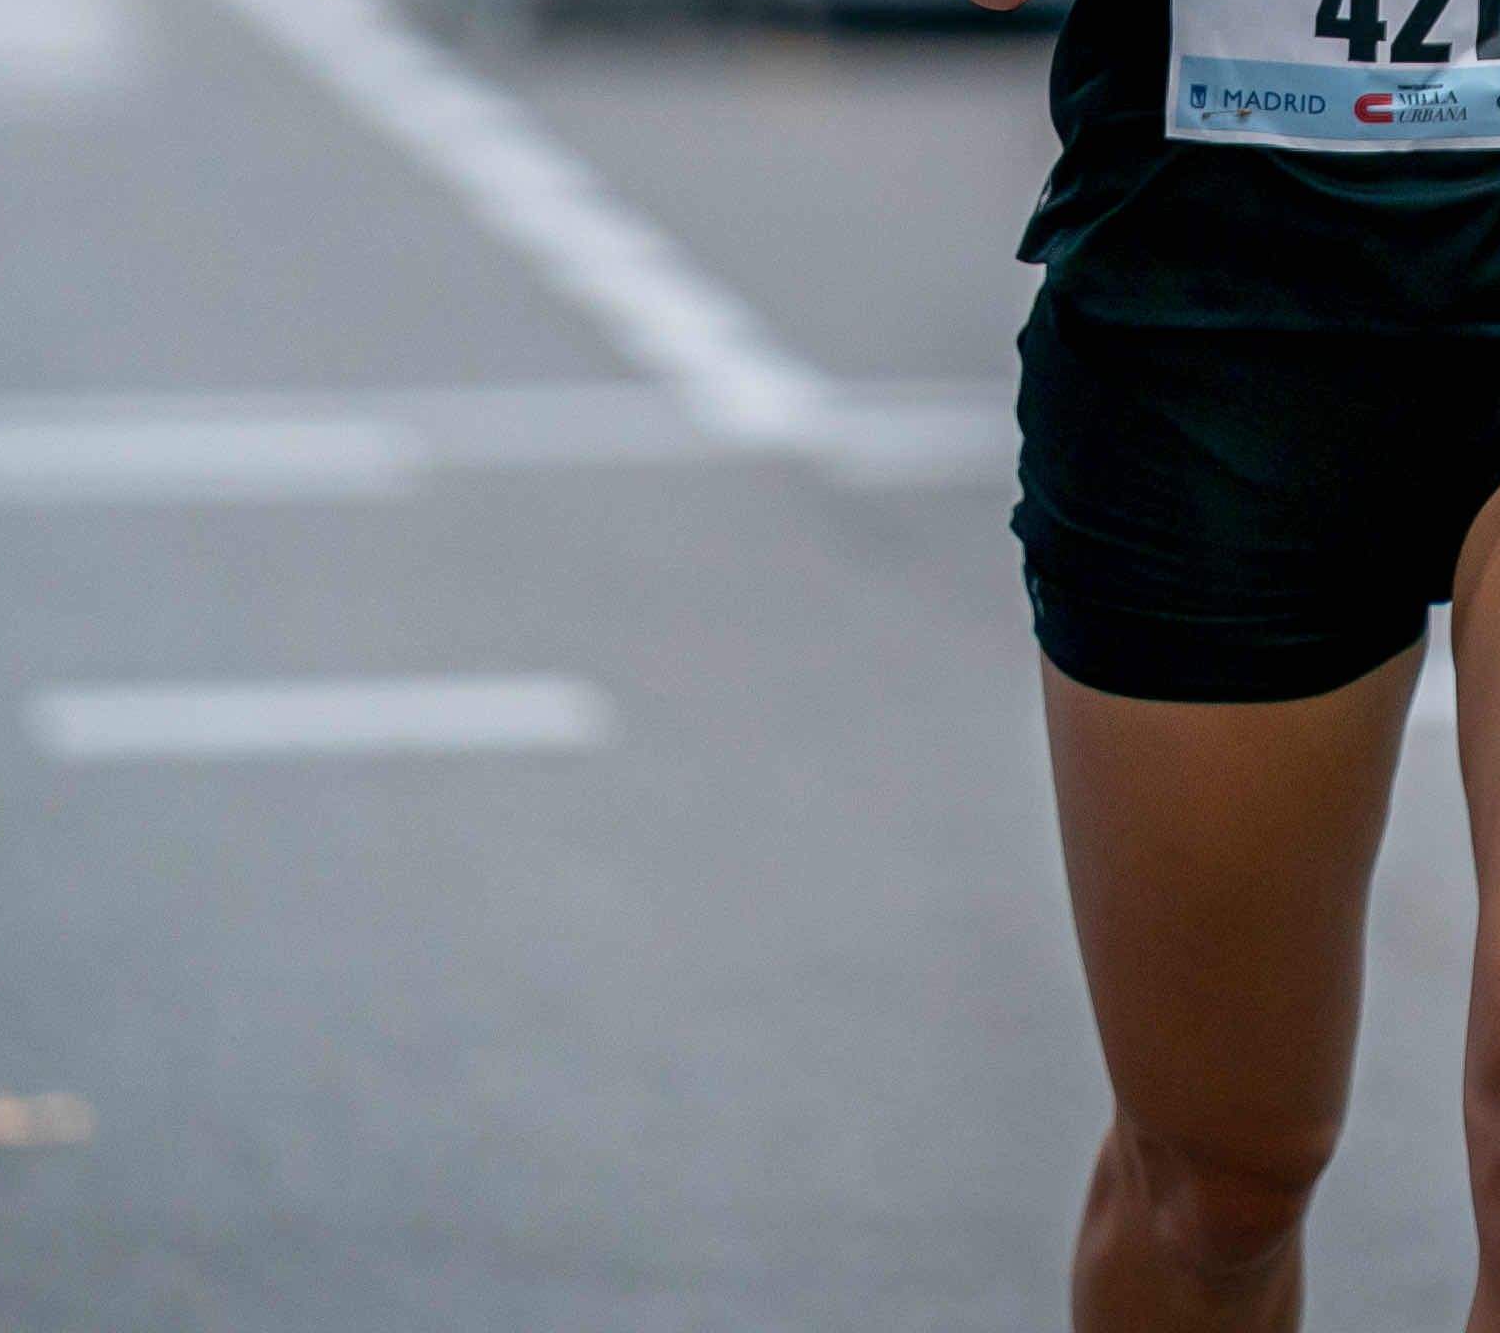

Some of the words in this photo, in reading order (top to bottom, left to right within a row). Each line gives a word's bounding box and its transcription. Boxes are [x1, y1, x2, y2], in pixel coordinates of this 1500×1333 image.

[1223, 89, 1326, 115] MADRID
[1397, 90, 1458, 106] MILLA
[1397, 106, 1468, 124] URBANA
